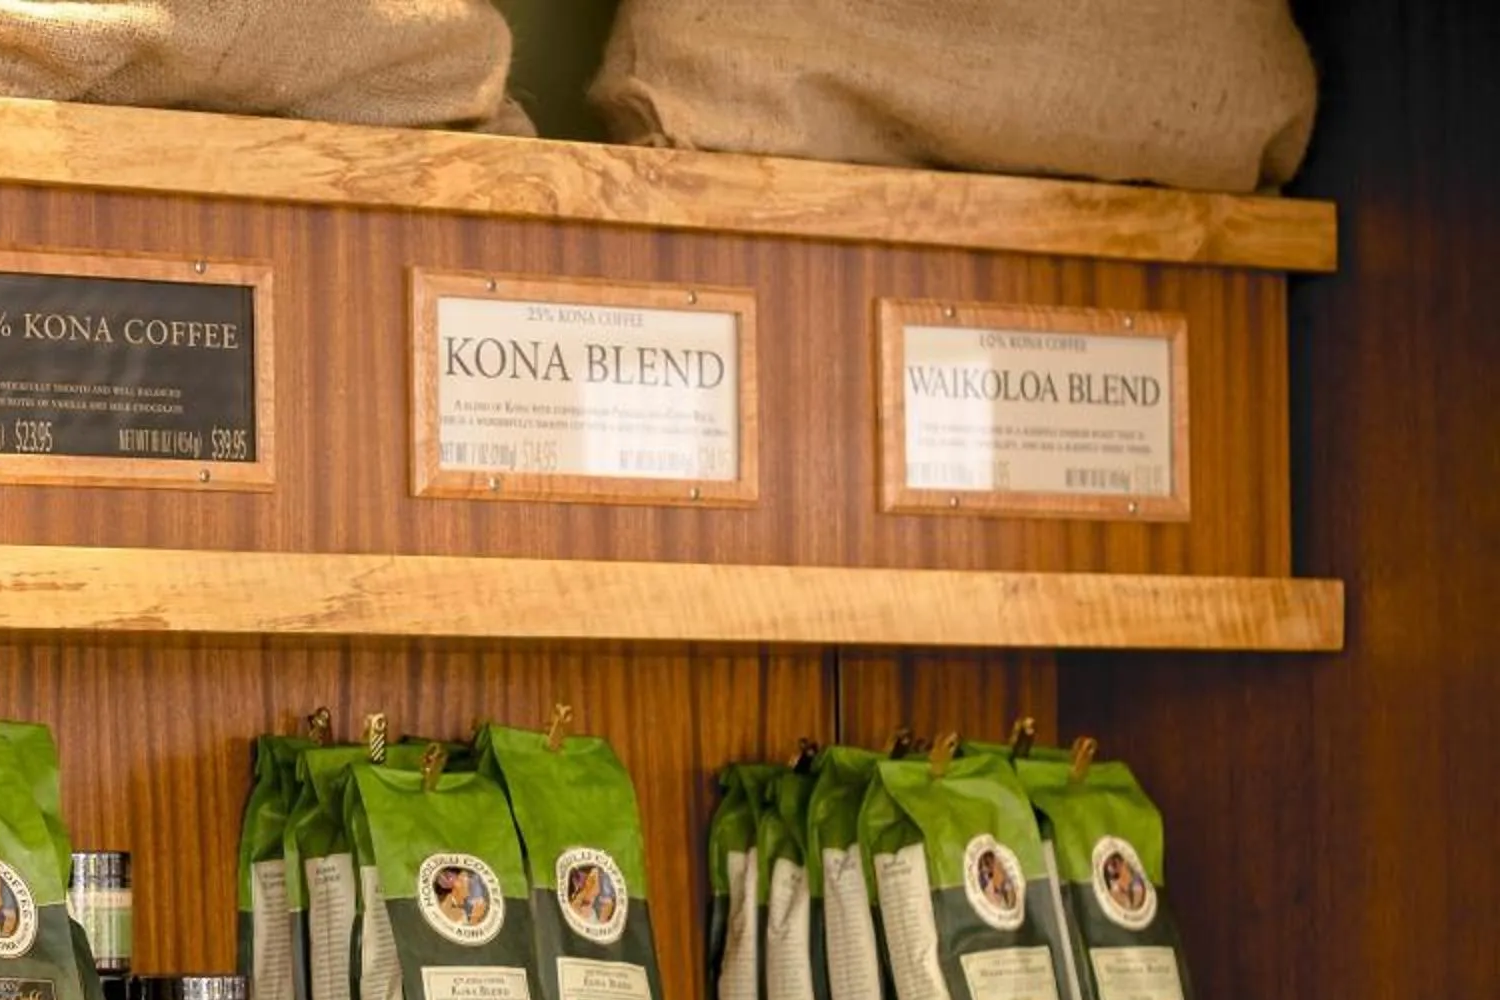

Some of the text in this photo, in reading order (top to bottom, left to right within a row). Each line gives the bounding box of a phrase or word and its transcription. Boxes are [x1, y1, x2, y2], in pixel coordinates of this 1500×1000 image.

[23, 312, 114, 344] KONA
[125, 318, 239, 350] COFFEE
[558, 308, 596, 325] KONA
[444, 335, 726, 390] KONA BLEND
[908, 365, 1161, 407] WAIKOLOA BLEND
[15, 417, 53, 453] $23.95
[119, 428, 135, 451] NET
[211, 424, 249, 461] $39.95
